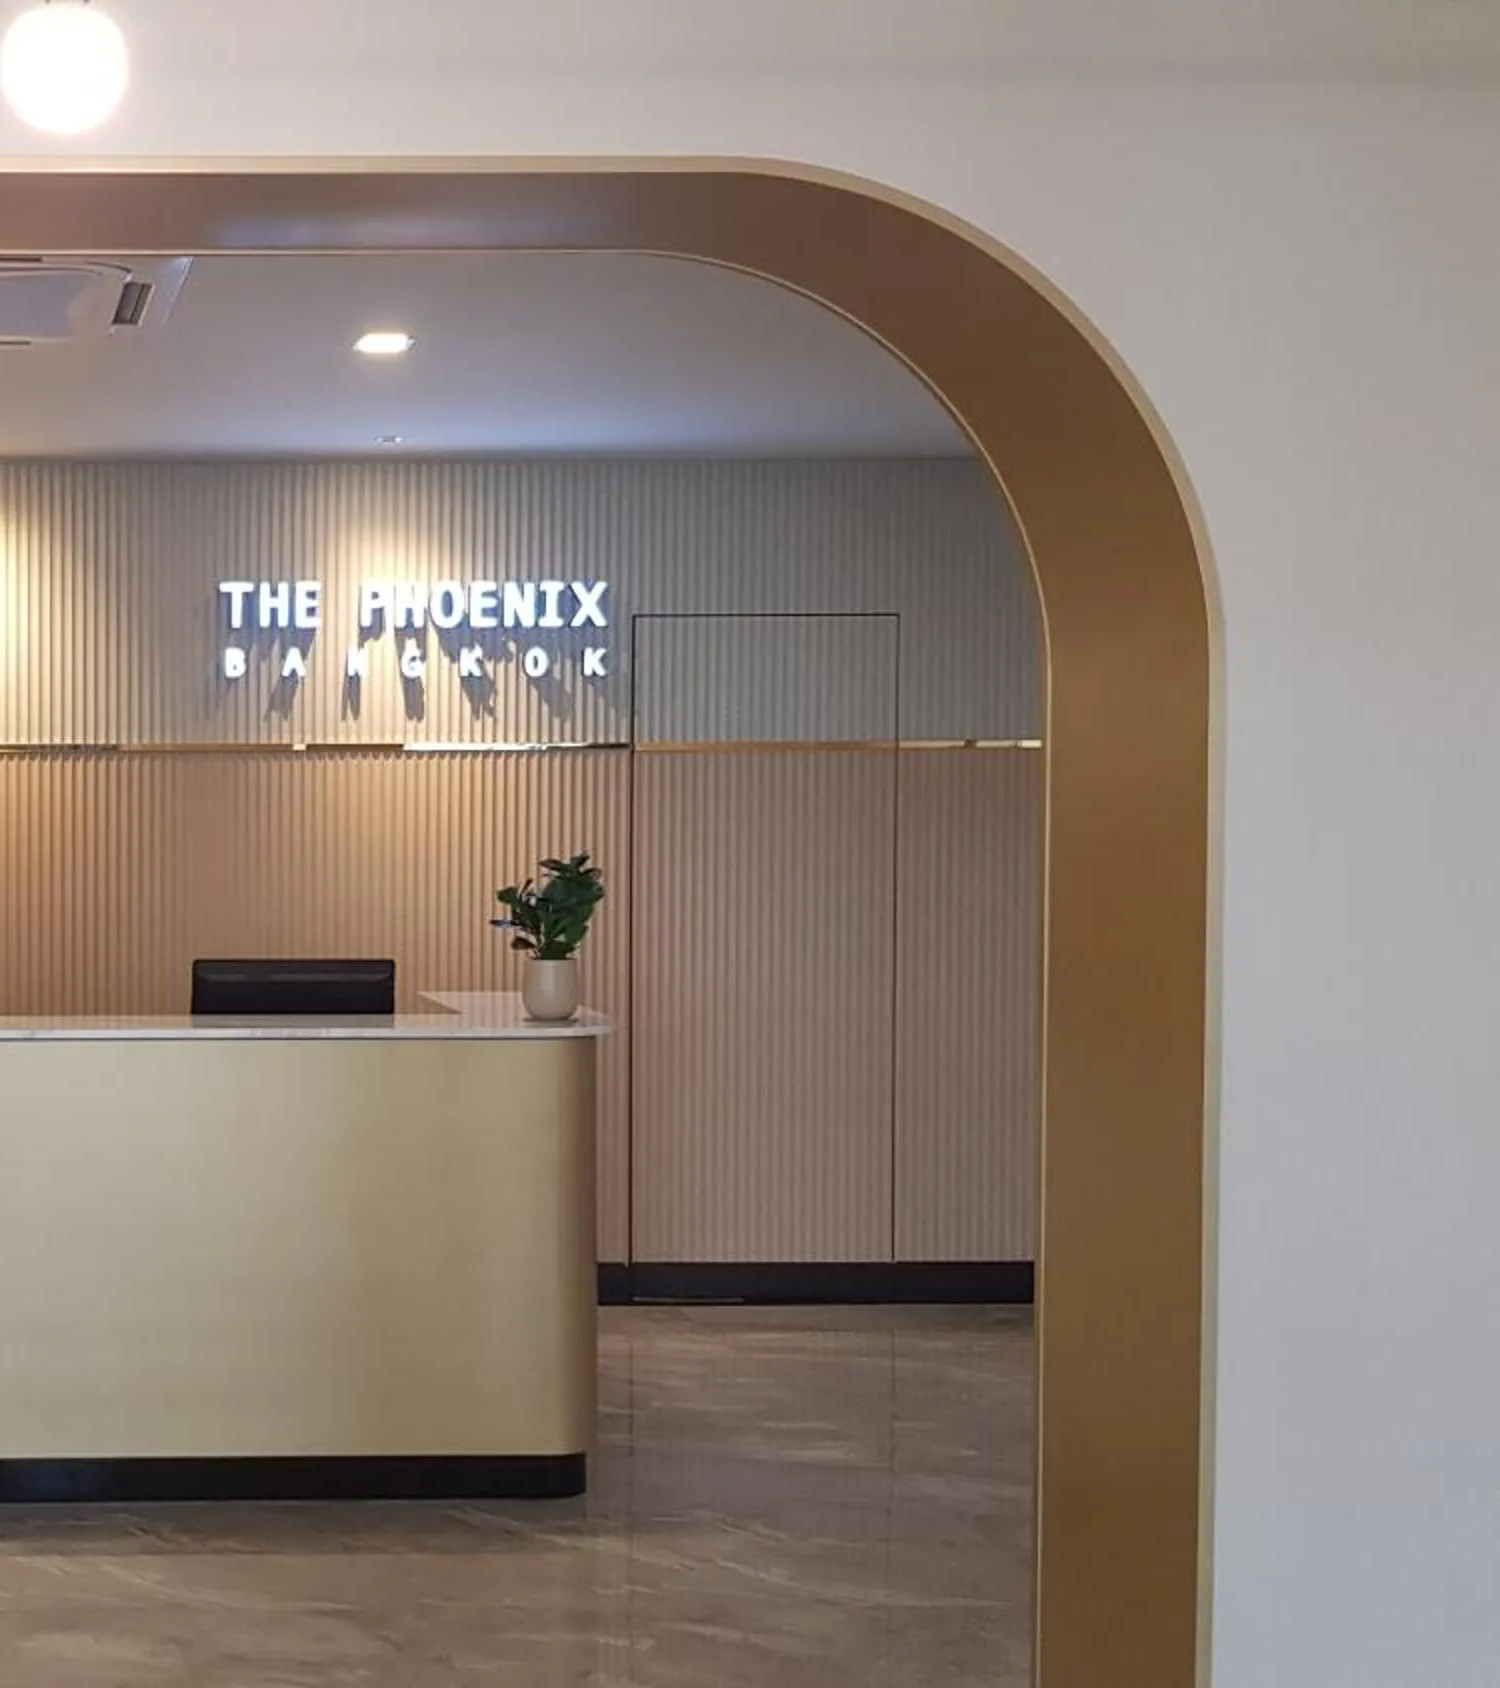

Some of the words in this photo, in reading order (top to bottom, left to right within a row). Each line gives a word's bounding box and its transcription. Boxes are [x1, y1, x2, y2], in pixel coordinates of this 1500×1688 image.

[219, 581, 322, 629] THE
[360, 581, 609, 629] PHOENIX
[223, 647, 608, 679] BANGKOK
